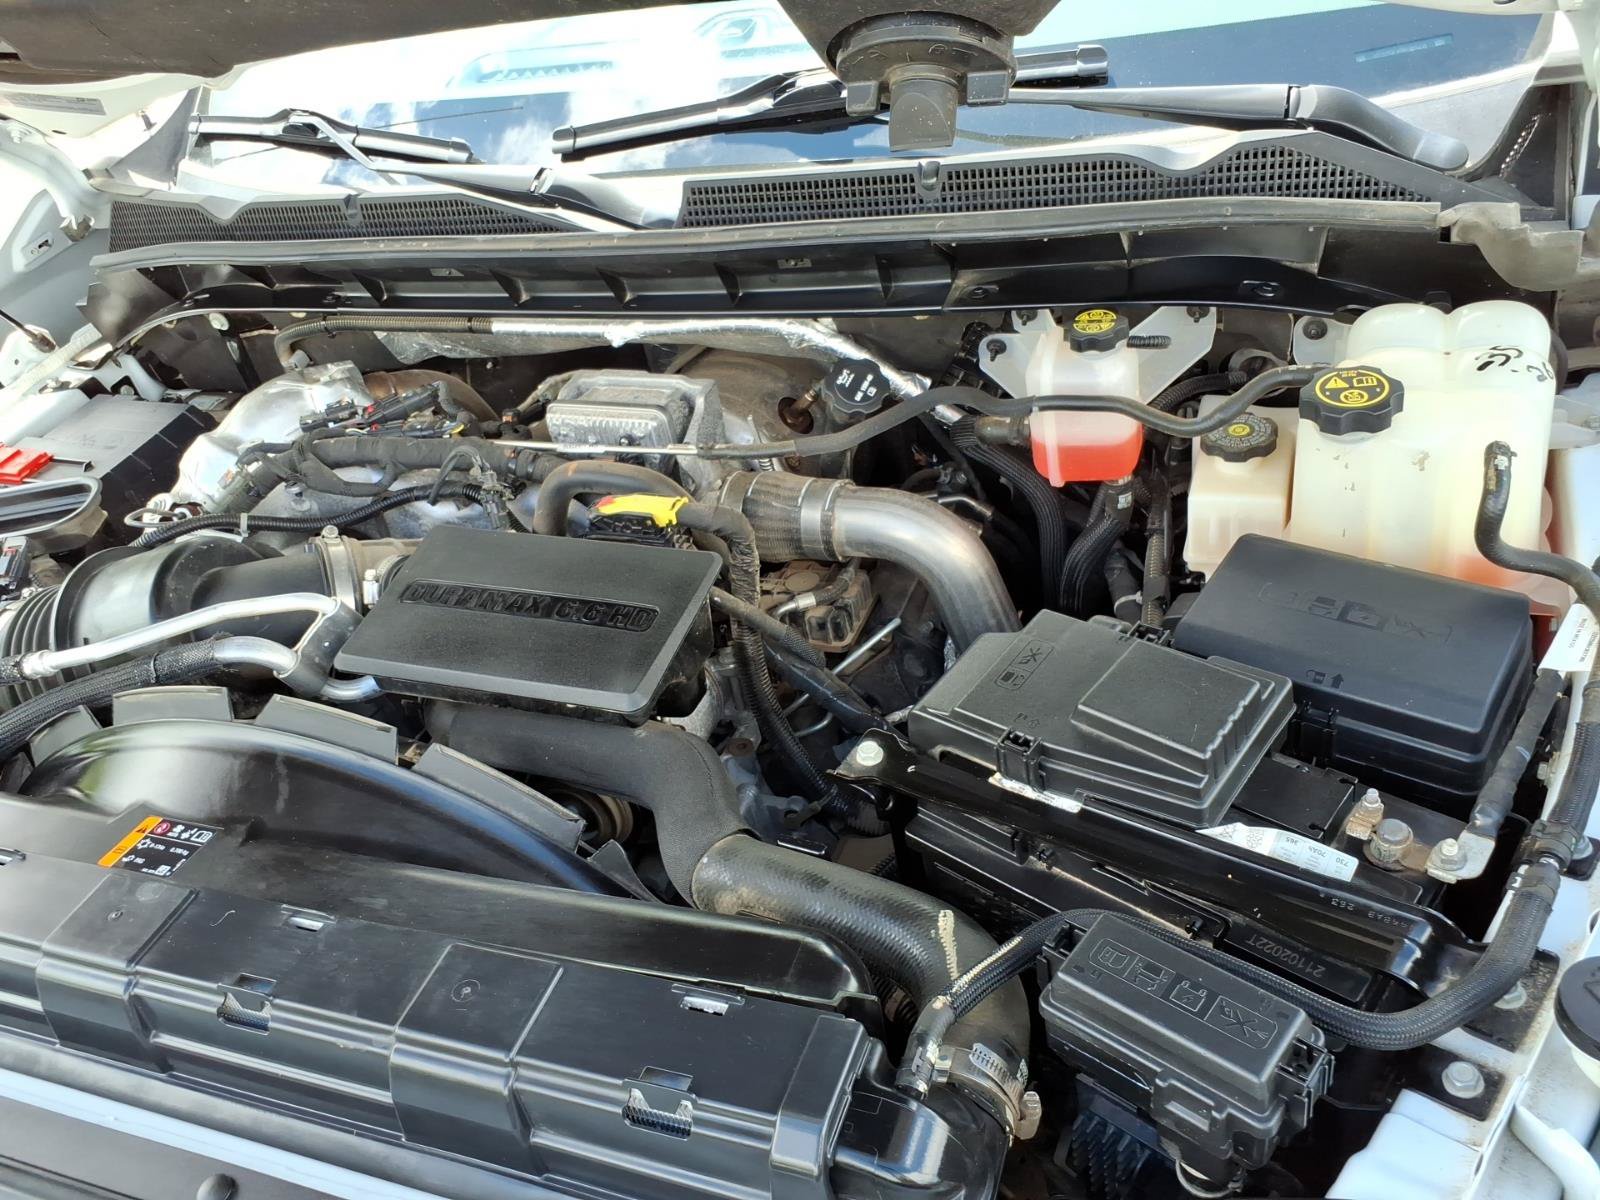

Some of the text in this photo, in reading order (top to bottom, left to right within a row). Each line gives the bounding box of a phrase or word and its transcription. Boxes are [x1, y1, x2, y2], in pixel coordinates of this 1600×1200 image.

[400, 583, 551, 618] DURAMAX
[606, 606, 658, 631] HD
[1245, 934, 1327, 978] 21102022T
